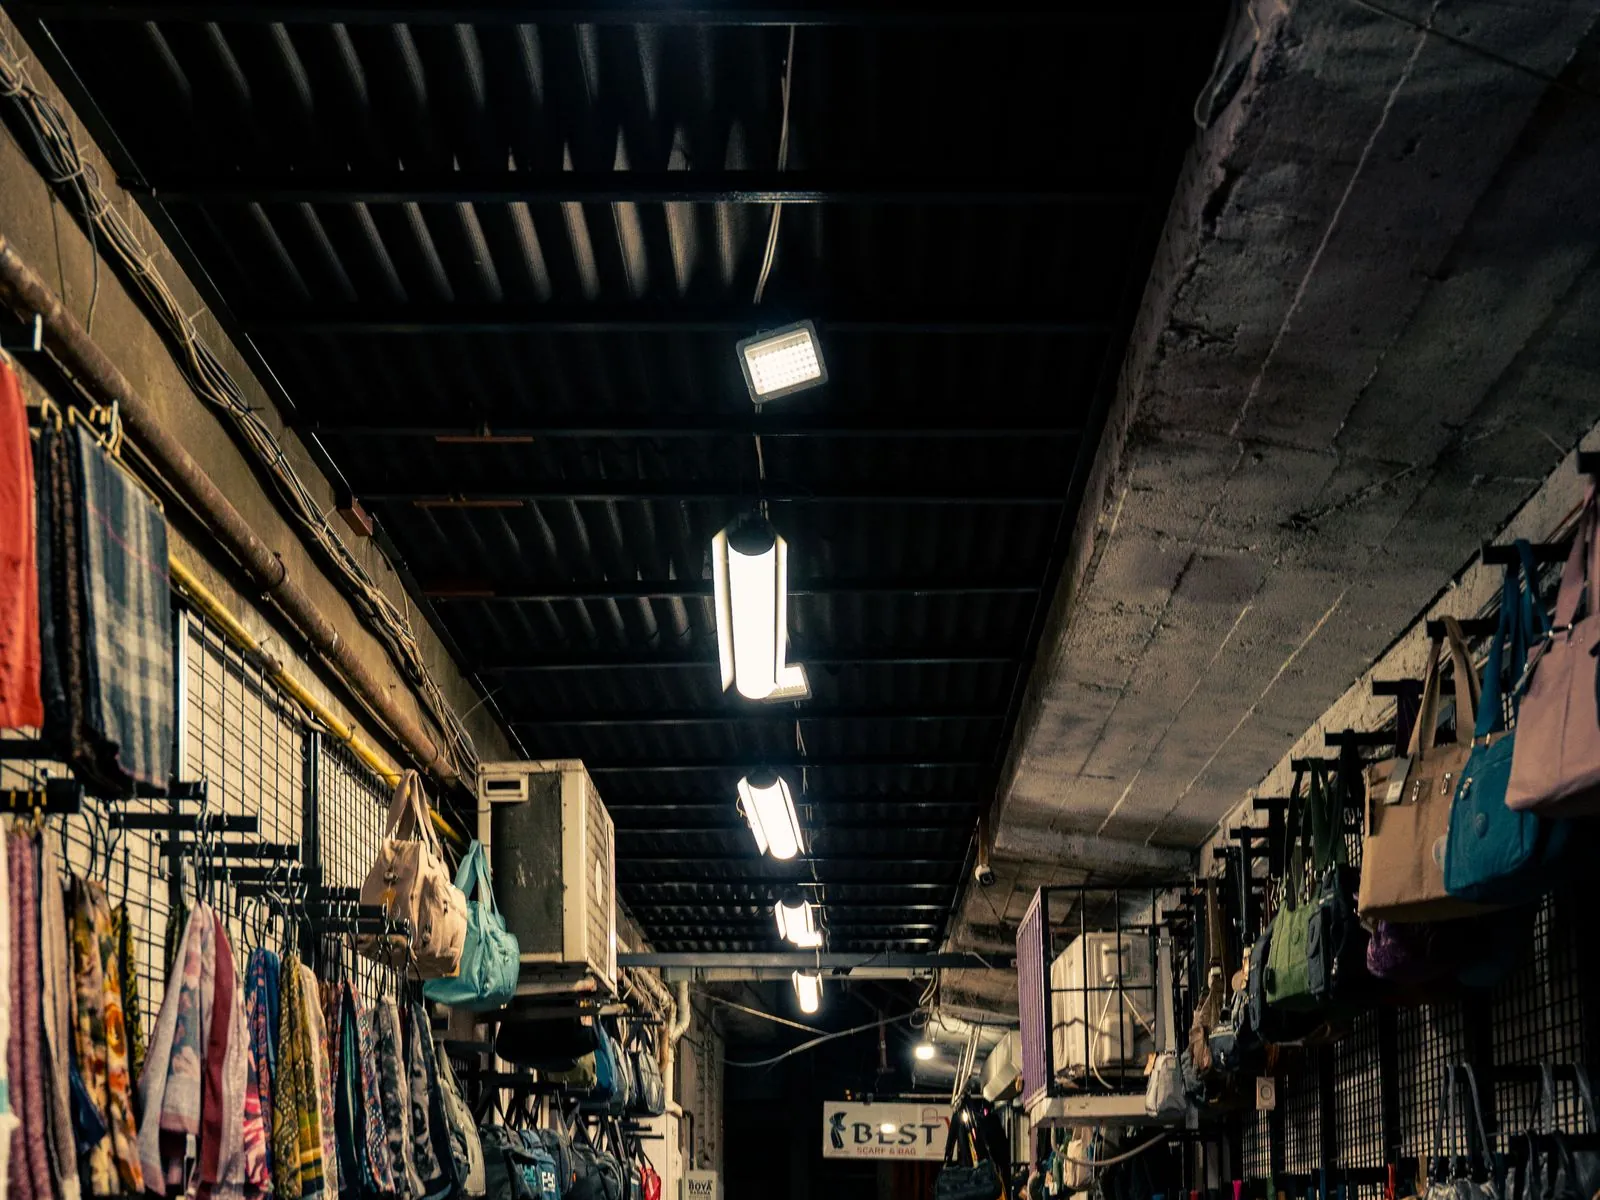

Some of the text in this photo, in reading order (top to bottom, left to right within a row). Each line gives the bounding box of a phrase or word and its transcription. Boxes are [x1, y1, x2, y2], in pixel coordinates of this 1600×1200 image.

[852, 1122, 941, 1146] BEST
[856, 1146, 885, 1156] SCARF
[889, 1147, 896, 1156] &
[897, 1147, 917, 1156] BAG
